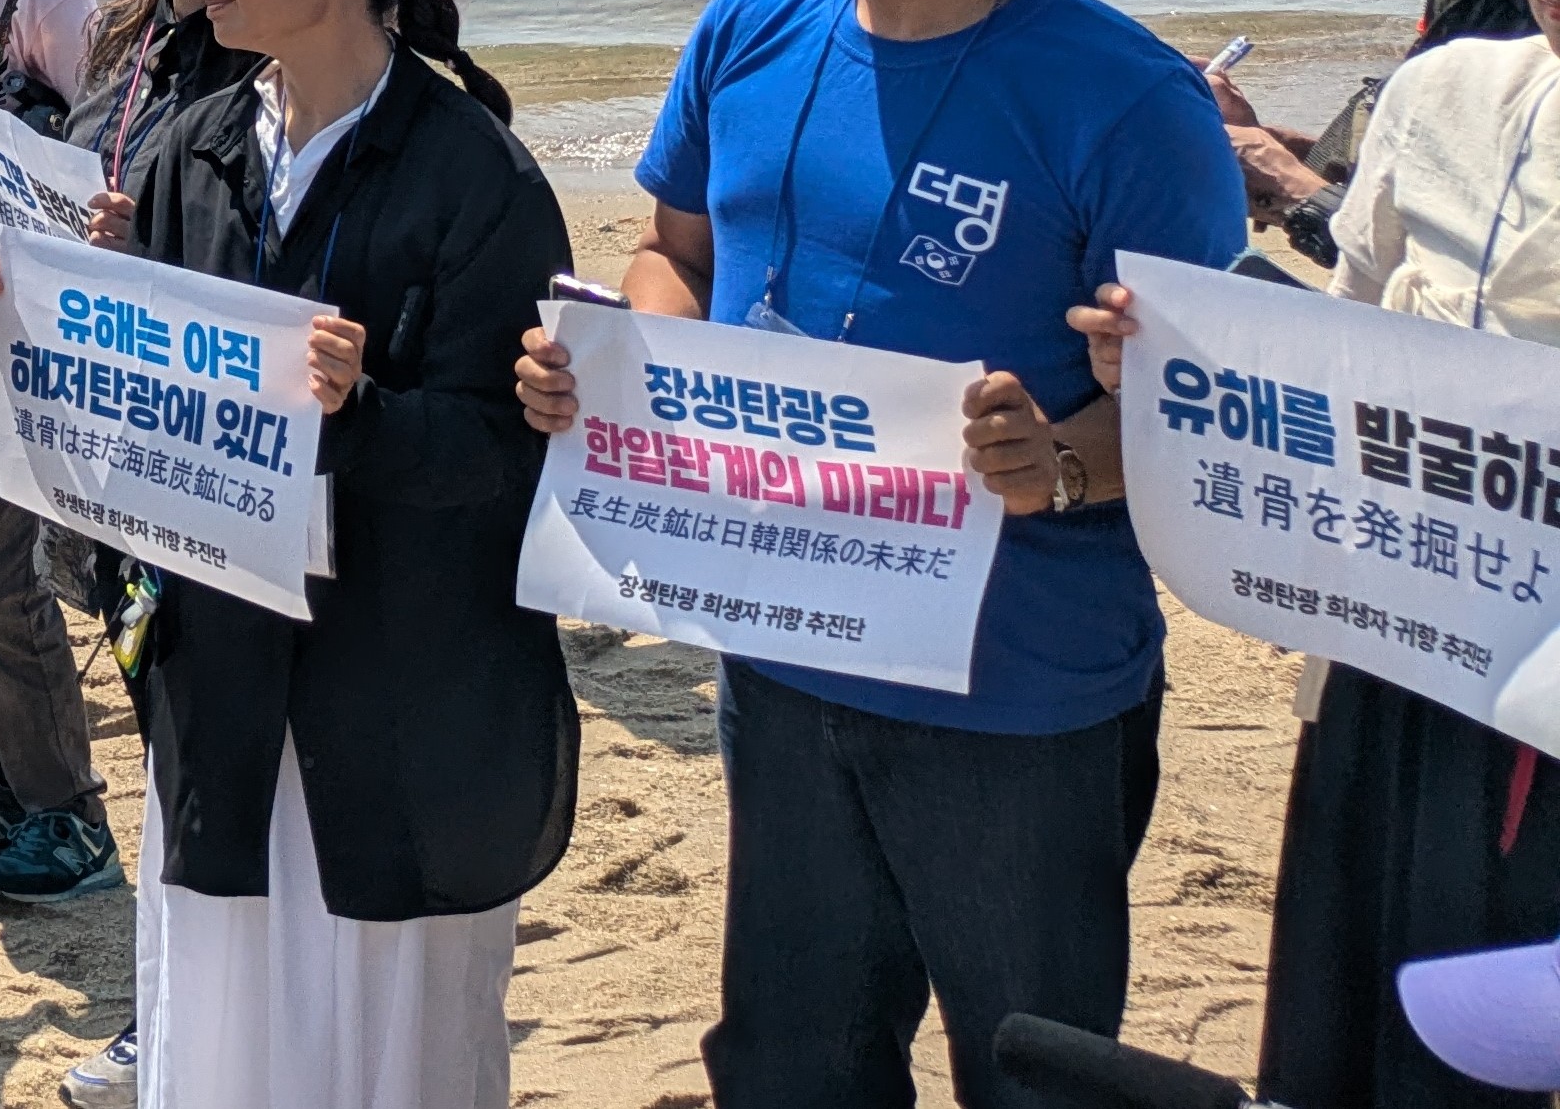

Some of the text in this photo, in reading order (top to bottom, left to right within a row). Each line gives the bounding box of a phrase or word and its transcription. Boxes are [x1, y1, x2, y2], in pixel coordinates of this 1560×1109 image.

[57, 289, 261, 393] 유해는 아직
[10, 339, 293, 477] 해저탄광에 있다.
[643, 361, 877, 453] 장생탄광은
[1158, 356, 1337, 468] 유해를
[14, 405, 276, 523] 遺骨はまだ海底炭鉱にある
[583, 415, 971, 531] 한일관계의 미래다
[52, 486, 227, 570] 장생탄광 희생자 귀향 추진단
[569, 486, 957, 581] 長生炭鉱は日韓関係の未来だ
[1192, 457, 1551, 605] 遺骨を発掘せよ
[618, 573, 866, 642] 장생탄광 희생자 귀향 추진단
[1231, 568, 1494, 678] 장생탄광 희생자 귀향 추진단
